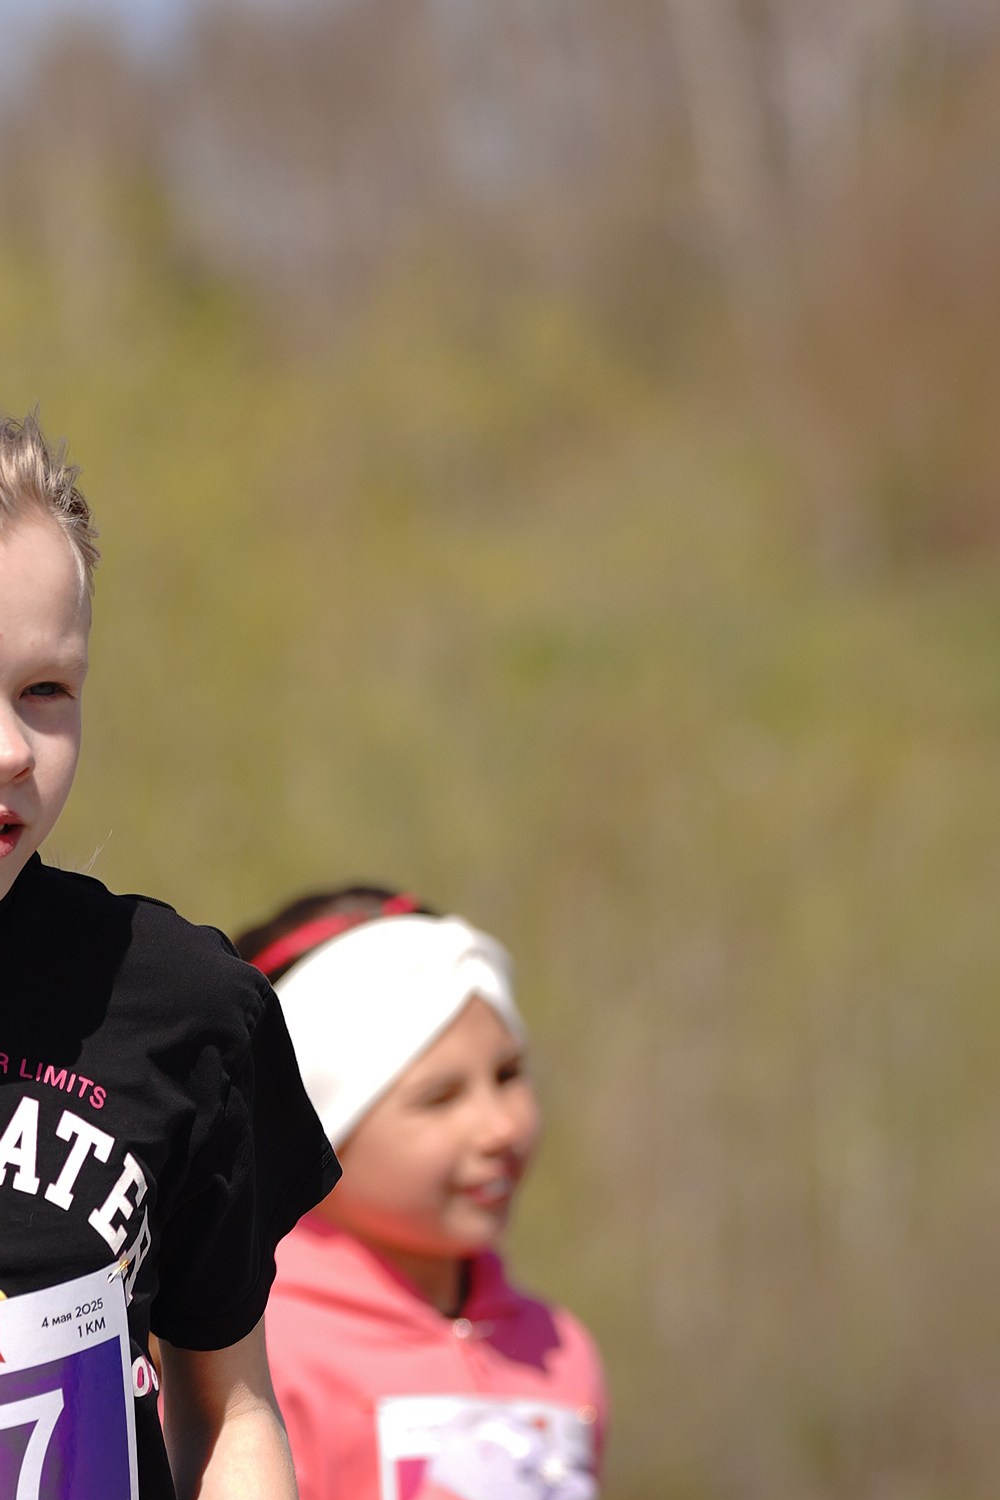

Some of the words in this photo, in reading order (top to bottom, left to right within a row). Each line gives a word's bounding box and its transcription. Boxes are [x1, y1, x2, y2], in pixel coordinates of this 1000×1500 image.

[19, 1058, 107, 1111] LIMITS
[41, 1317, 49, 1329] 4
[52, 1313, 72, 1327] мая
[75, 1298, 104, 1318] 2025
[77, 1325, 83, 1339] 1
